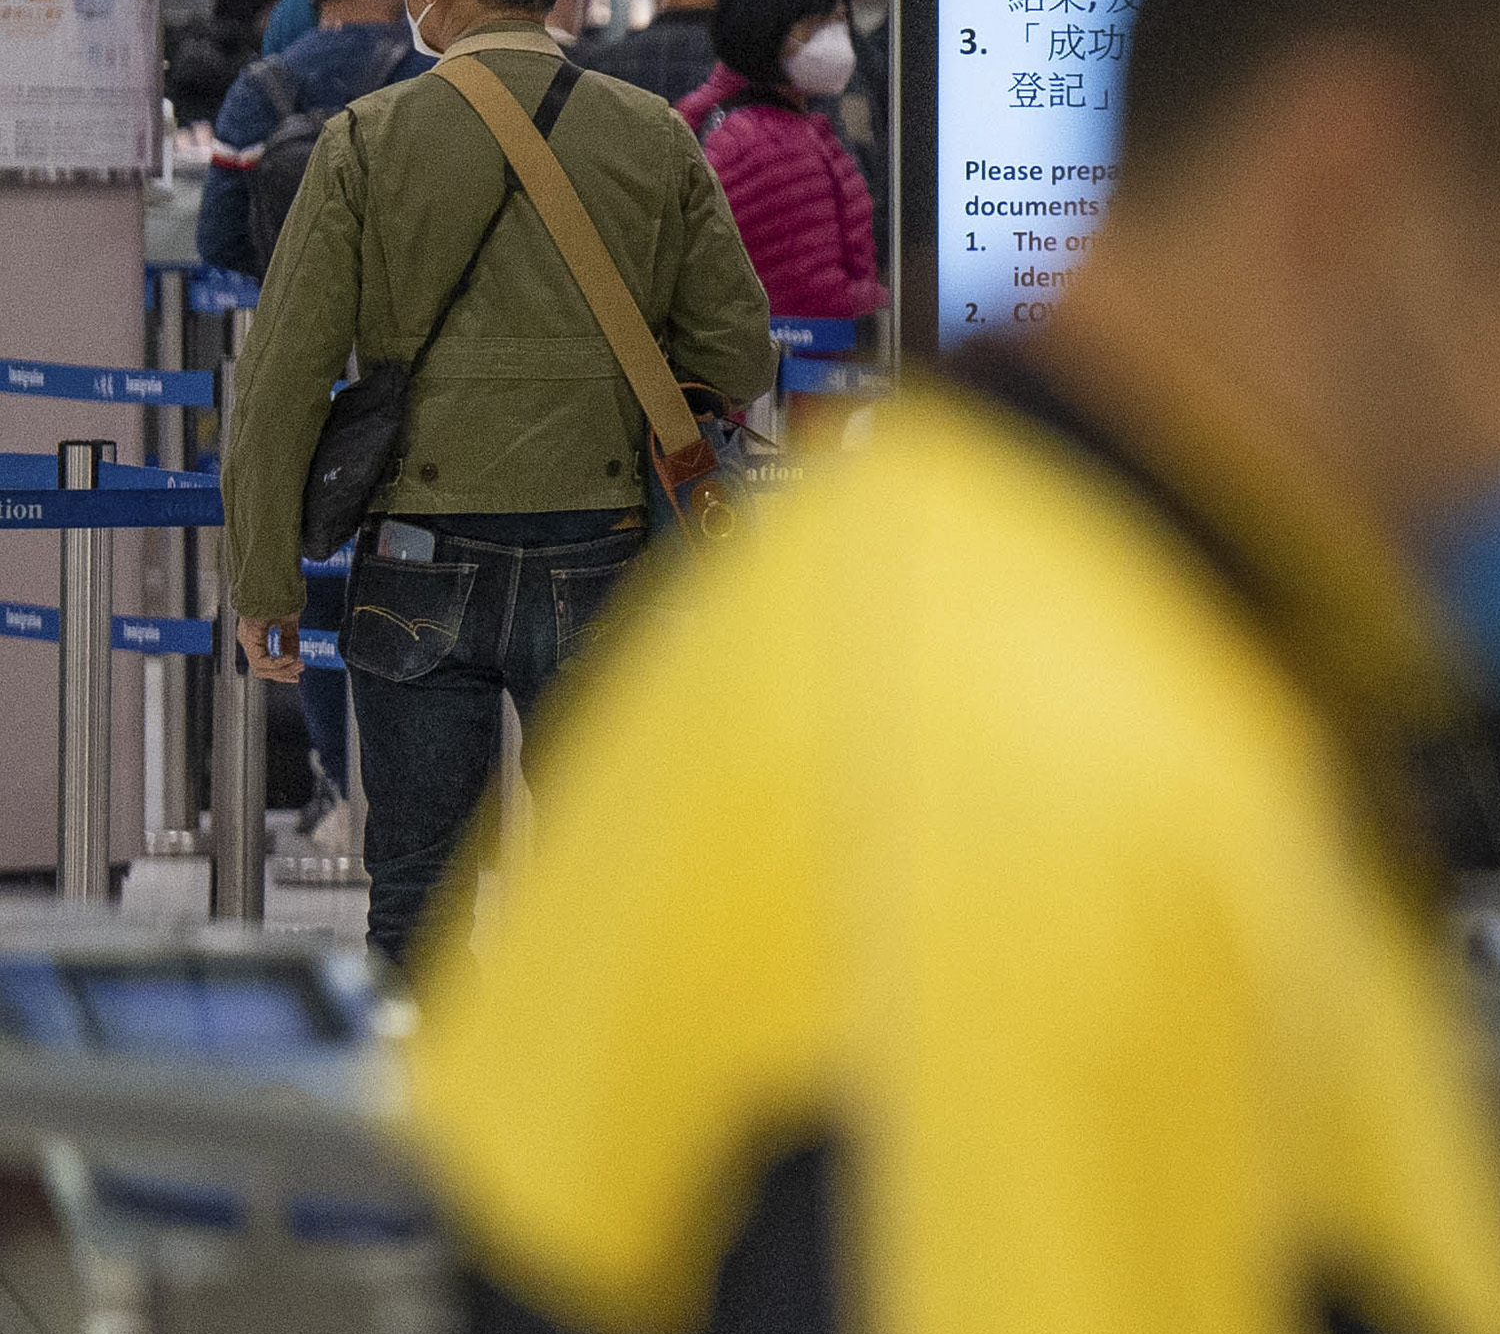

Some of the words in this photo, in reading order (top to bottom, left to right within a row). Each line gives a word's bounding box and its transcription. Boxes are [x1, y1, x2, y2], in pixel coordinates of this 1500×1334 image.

[959, 28, 987, 56] 3.
[964, 160, 1044, 182] Please
[964, 195, 1099, 217] documents
[965, 231, 987, 253] 1.
[1013, 230, 1057, 253] The
[965, 302, 987, 324] 2.
